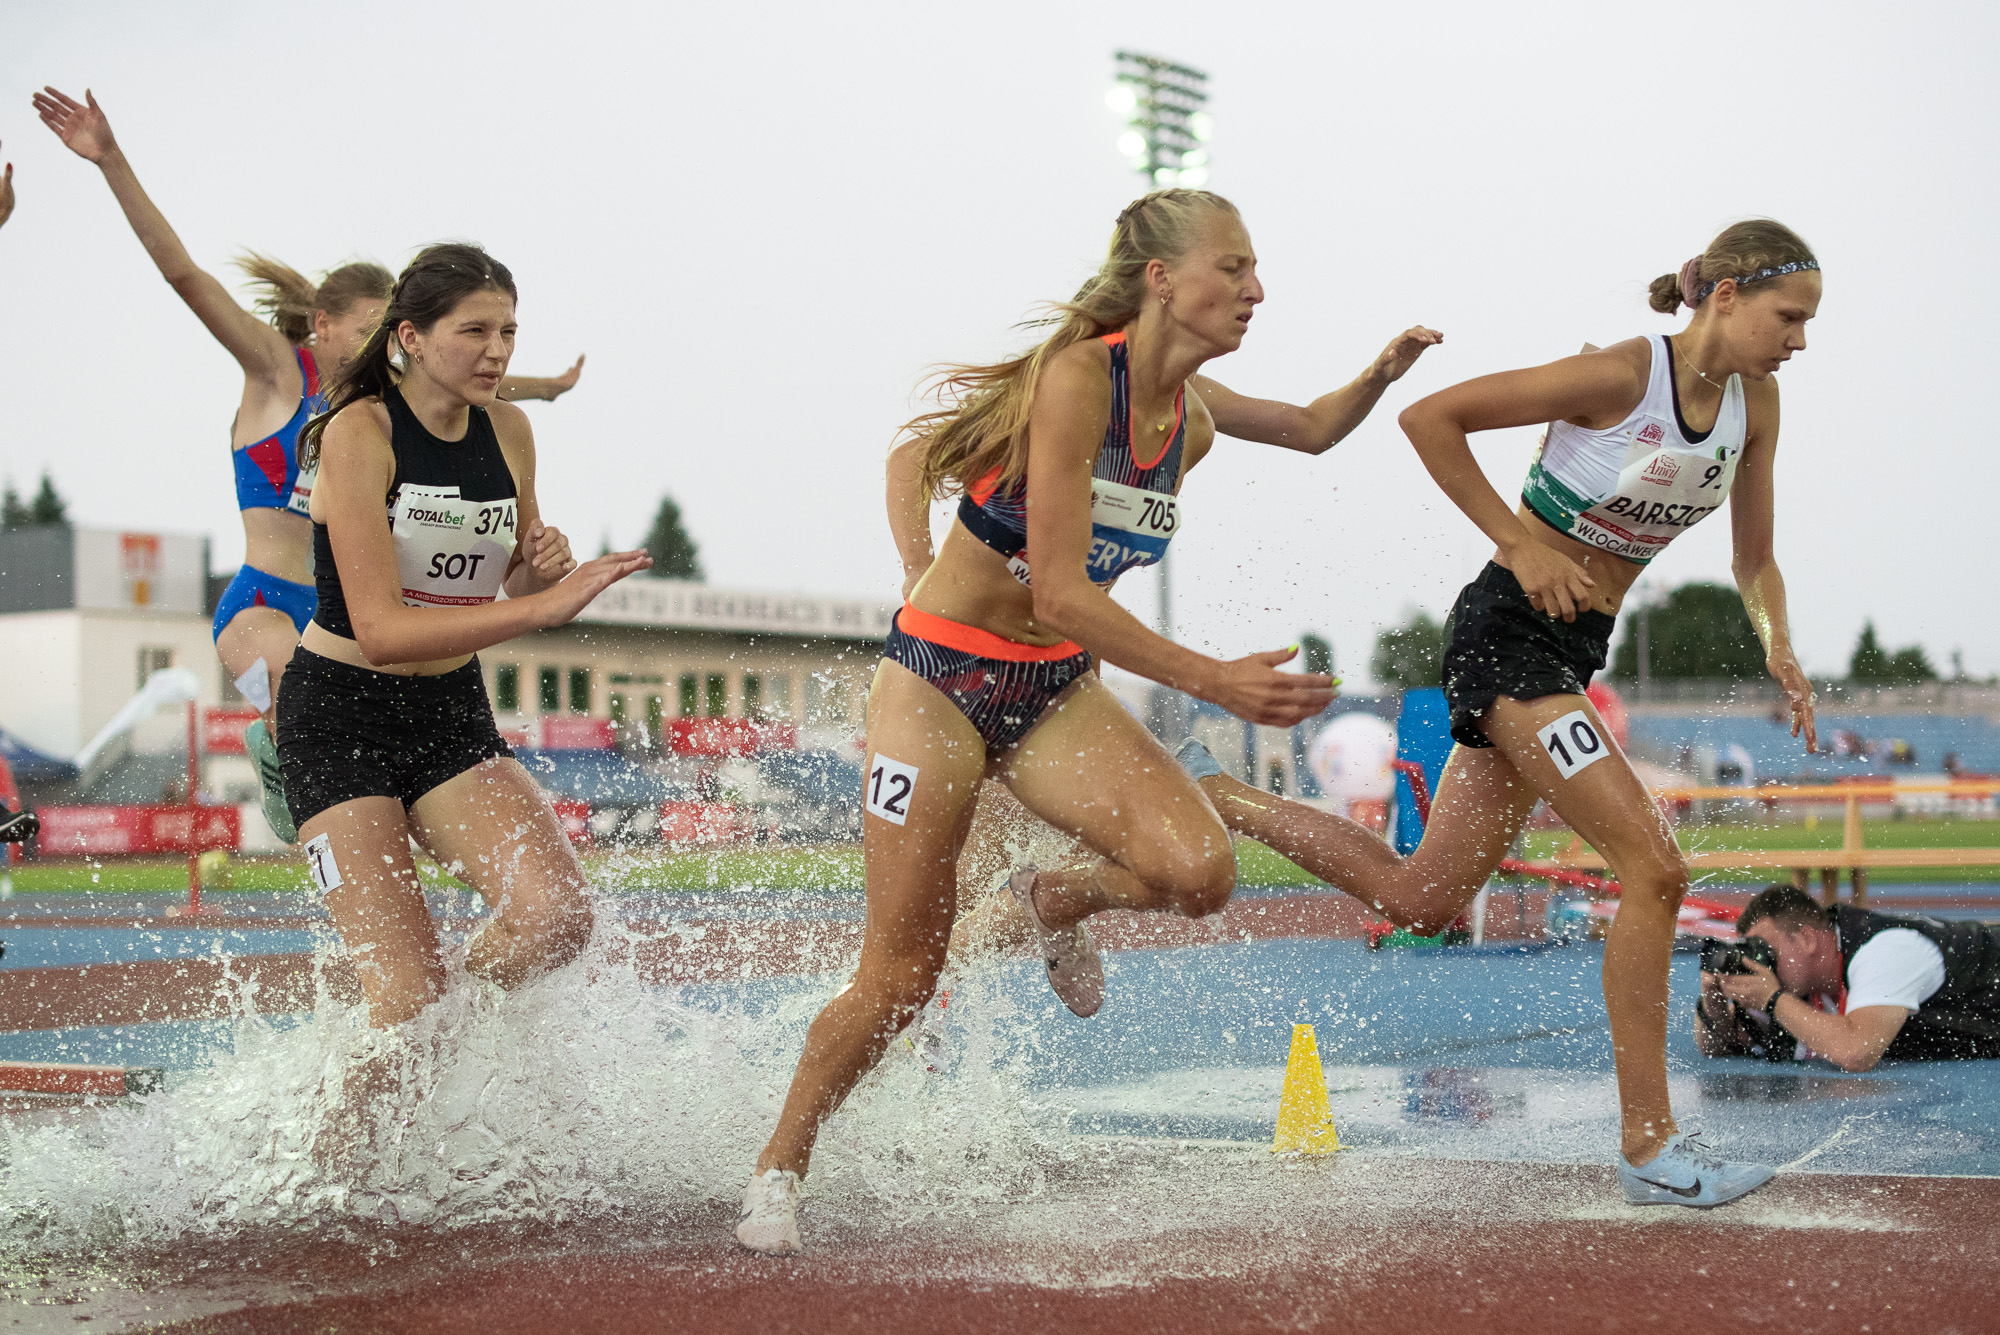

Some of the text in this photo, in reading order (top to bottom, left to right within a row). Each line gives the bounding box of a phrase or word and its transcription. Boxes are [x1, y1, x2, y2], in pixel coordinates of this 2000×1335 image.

[1643, 457, 1681, 478] Anwil
[1698, 465, 1723, 489] 9
[407, 508, 466, 526] TOTALbet
[474, 504, 515, 535] 374
[1136, 497, 1176, 532] 705
[426, 552, 485, 580] SOT
[414, 592, 467, 604] MISTRZOSTWA
[1548, 720, 1599, 767] 10
[871, 766, 911, 816] 12
